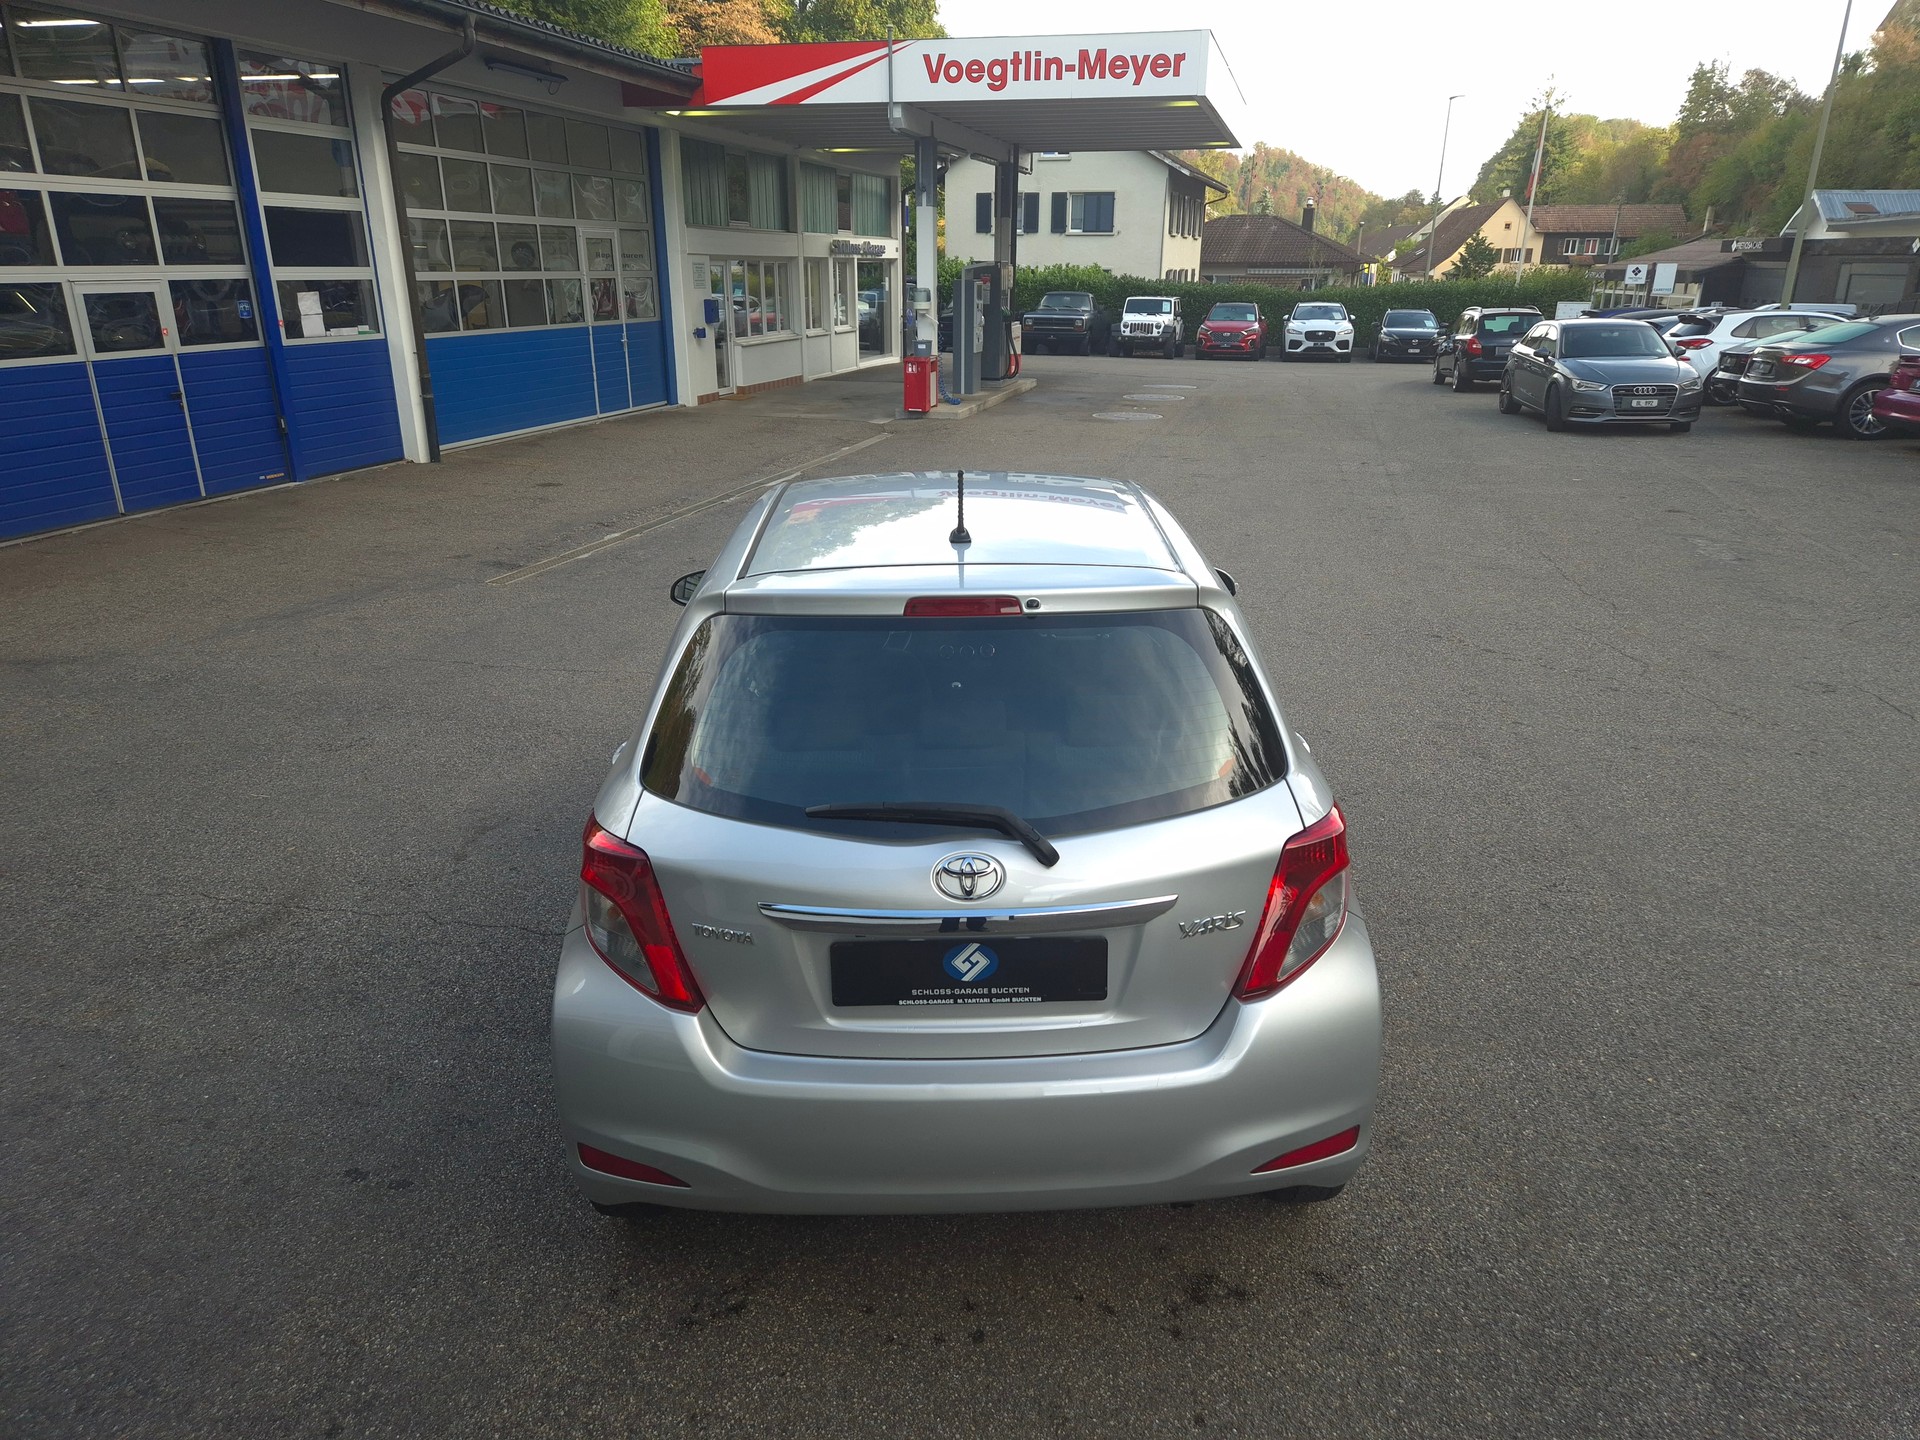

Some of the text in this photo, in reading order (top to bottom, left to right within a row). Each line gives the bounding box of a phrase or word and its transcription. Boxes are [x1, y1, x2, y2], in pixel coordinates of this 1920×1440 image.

[922, 48, 1187, 92] Voegtlin-Meyer
[691, 922, 756, 946] TOYOTA
[911, 986, 1030, 996] SCHLOSS-GARAGE BUCKTEN
